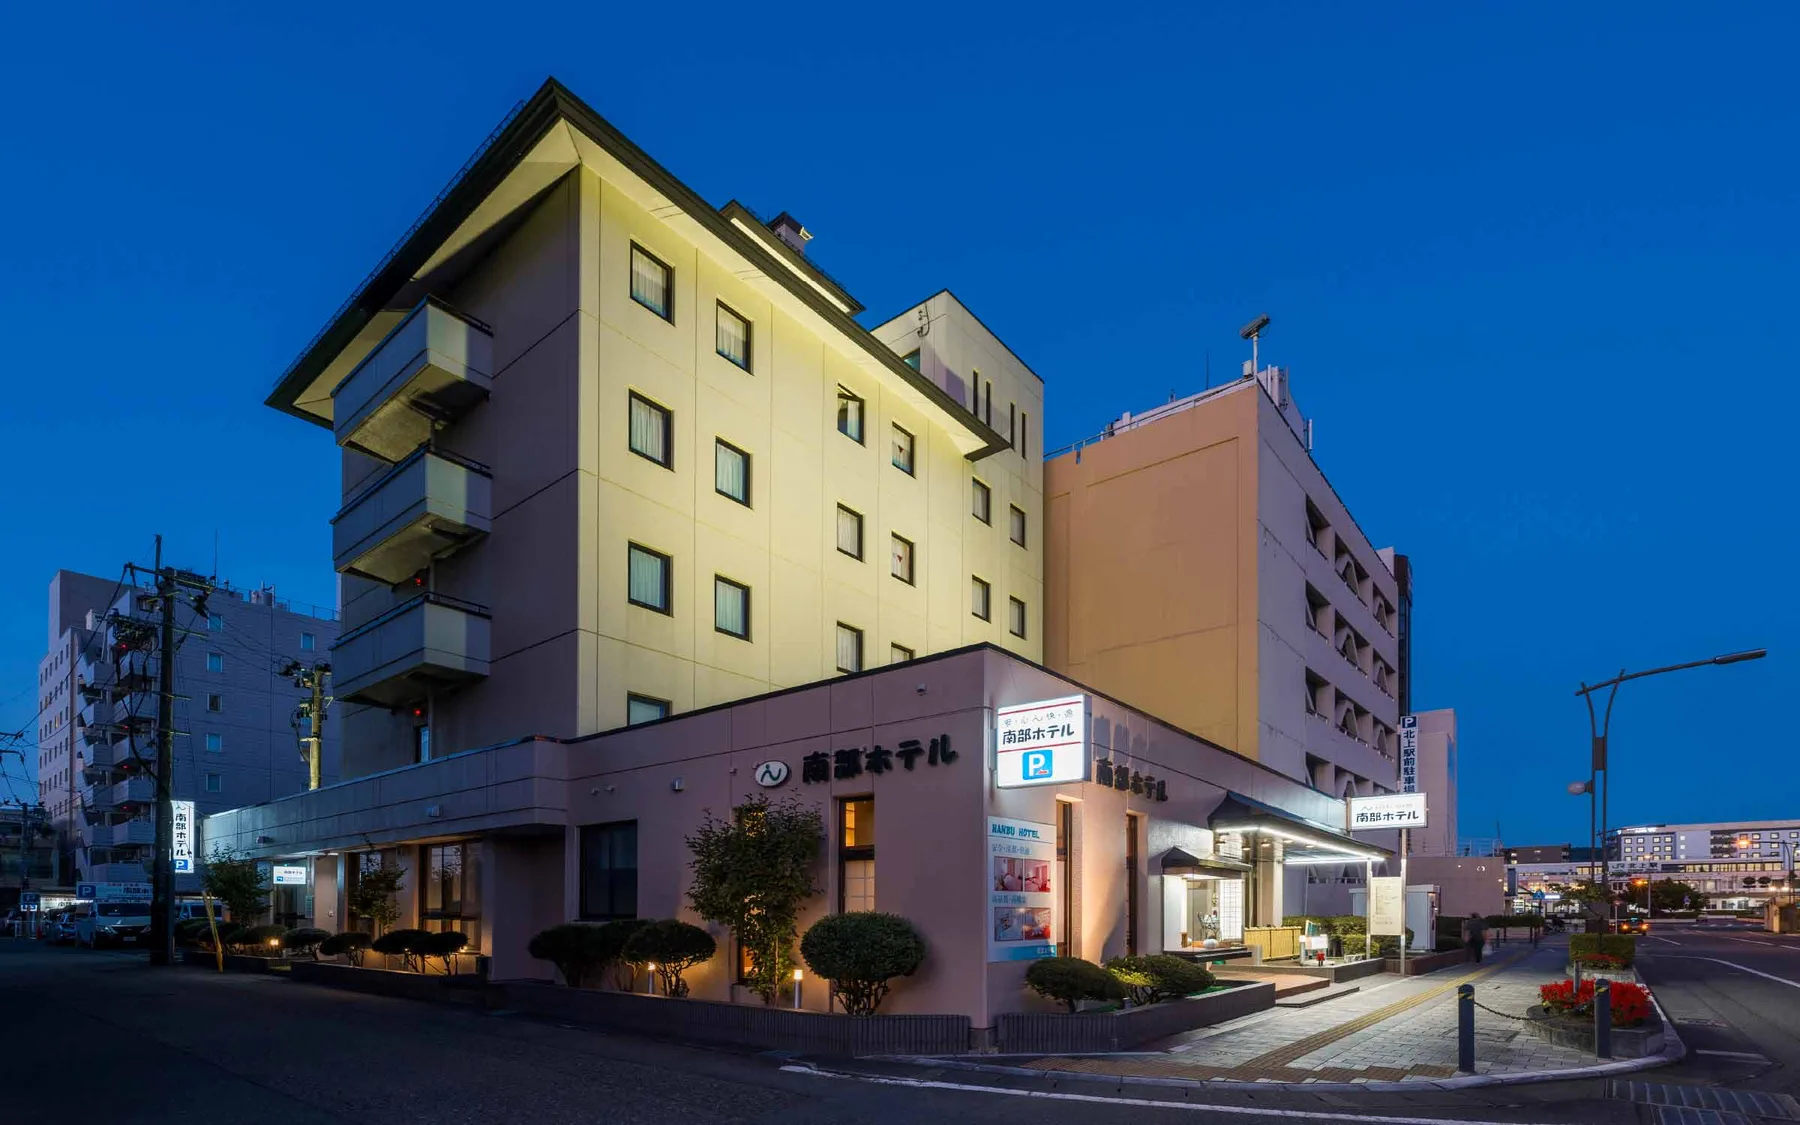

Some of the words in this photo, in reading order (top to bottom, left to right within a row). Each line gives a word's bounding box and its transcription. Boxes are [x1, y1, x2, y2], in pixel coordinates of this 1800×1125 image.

[1404, 717, 1414, 728] P
[1002, 723, 1075, 745] 南部ホテル
[803, 734, 959, 785] 南部ホテル
[1028, 753, 1046, 777] P
[1403, 729, 1416, 793] 北上駅前駐車場
[1356, 810, 1419, 823] 南部ホテル
[175, 813, 187, 857] 南部ホテル
[1019, 827, 1040, 839] HOTEL
[175, 860, 185, 869] P
[82, 886, 93, 897] P
